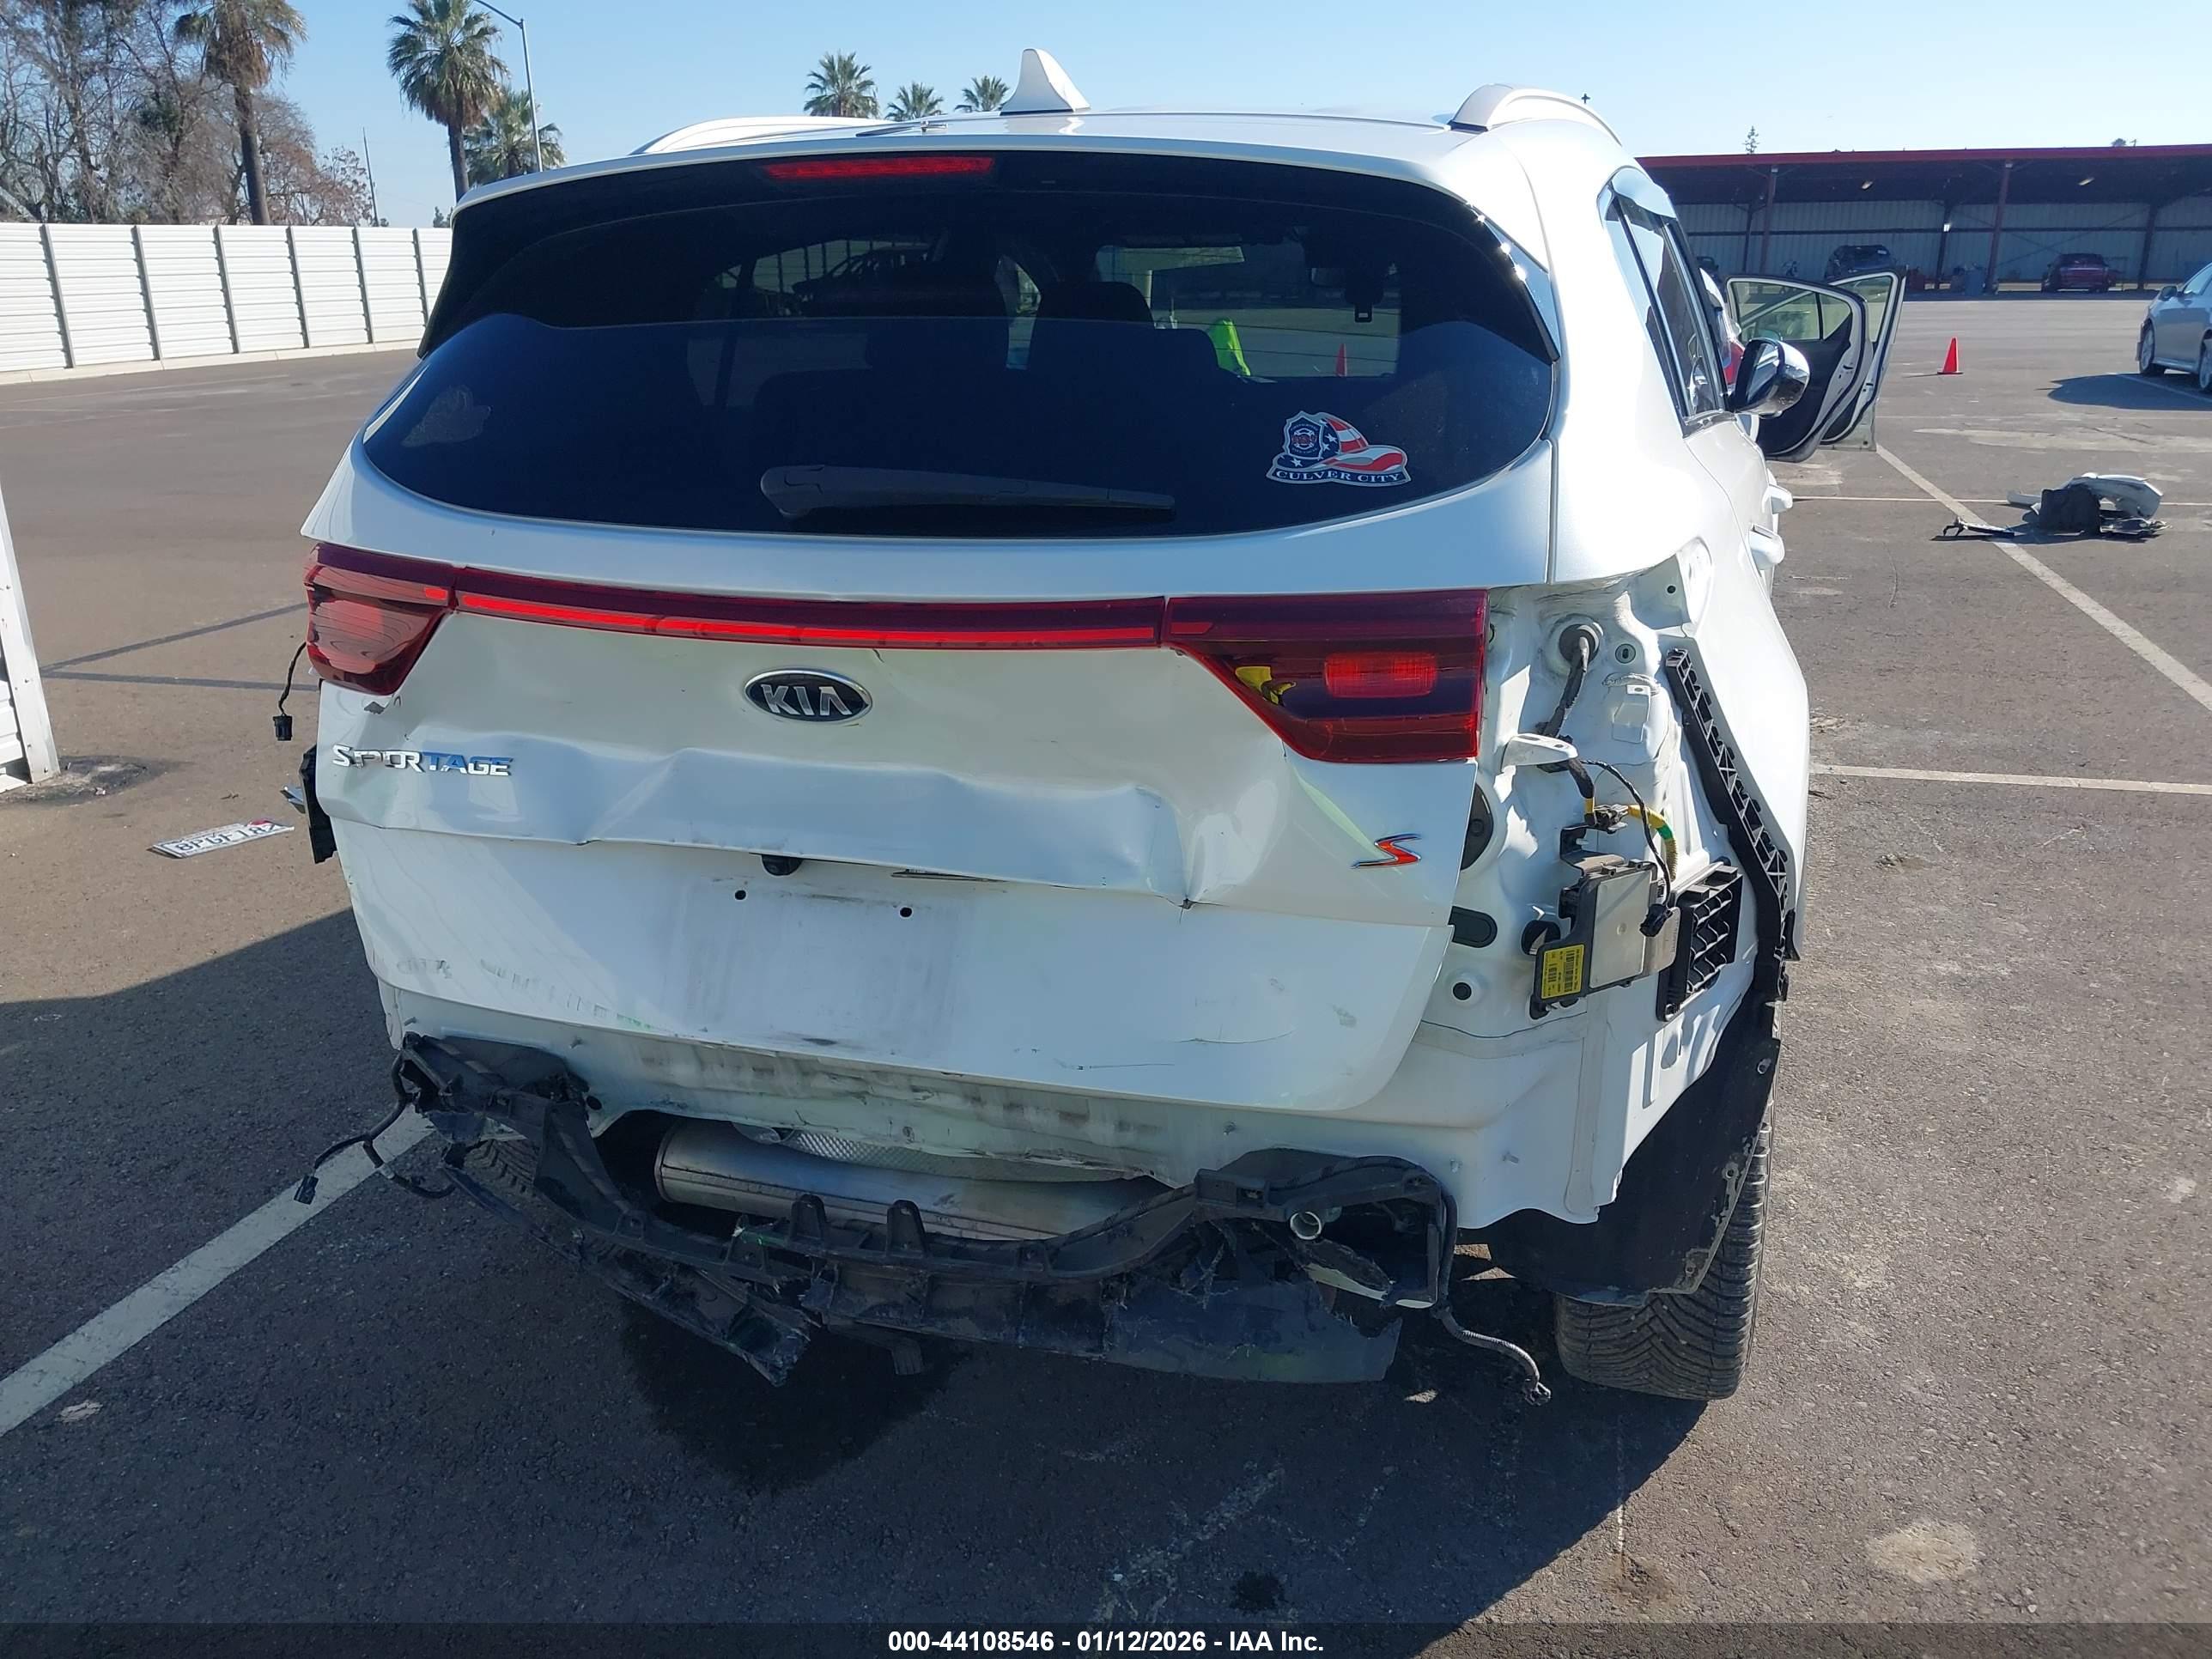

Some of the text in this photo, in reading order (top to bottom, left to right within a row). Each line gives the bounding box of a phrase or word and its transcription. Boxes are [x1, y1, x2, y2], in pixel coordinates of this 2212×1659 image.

[1275, 469, 1401, 483] CULVER CITY
[760, 684, 853, 716] KIA
[331, 744, 514, 776] SPORTAGE
